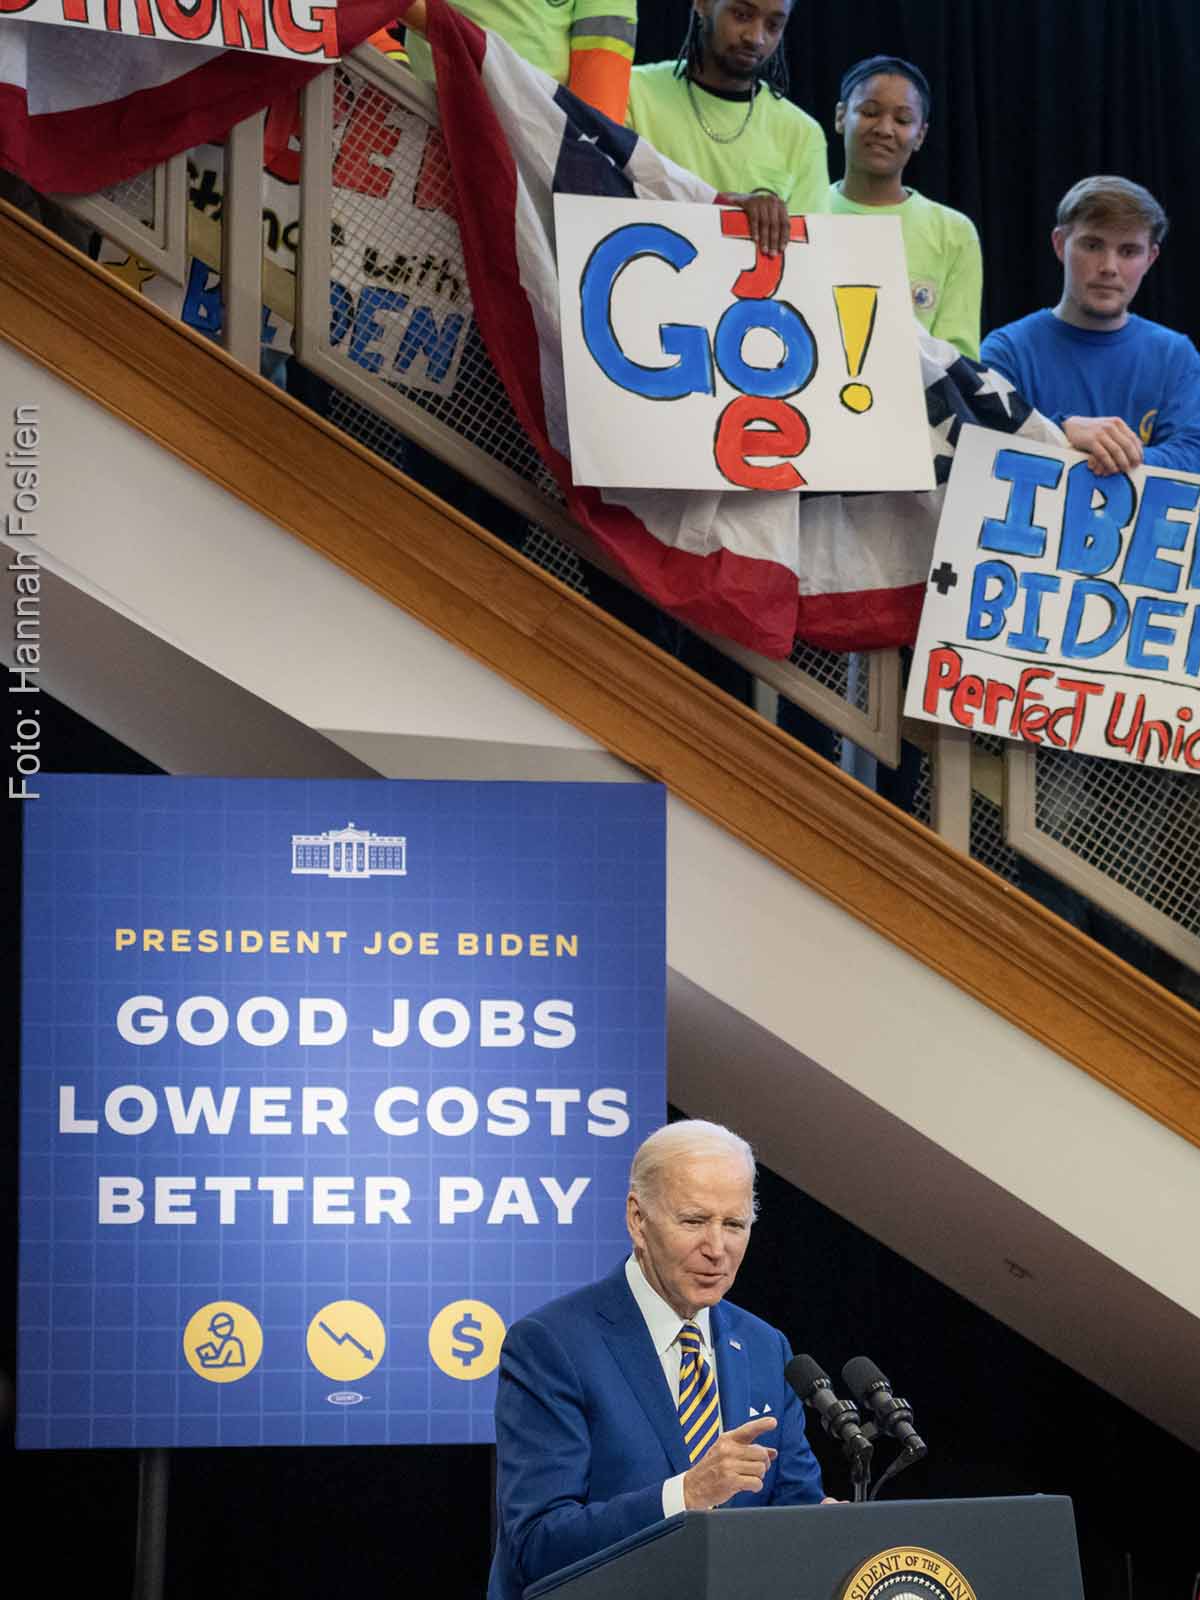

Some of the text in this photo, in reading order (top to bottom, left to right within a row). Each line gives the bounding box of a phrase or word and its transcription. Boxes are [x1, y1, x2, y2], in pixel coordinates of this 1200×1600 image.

[115, 928, 579, 957] PRESIDENT JOE BIDEN
[116, 995, 577, 1048] GOOD JOBS
[58, 1085, 632, 1137] LOWER COSTS
[98, 1175, 592, 1225] BETTER PAY
[905, 1555, 919, 1567] OF
[922, 1558, 940, 1575] THE
[944, 1572, 973, 1600] UN
